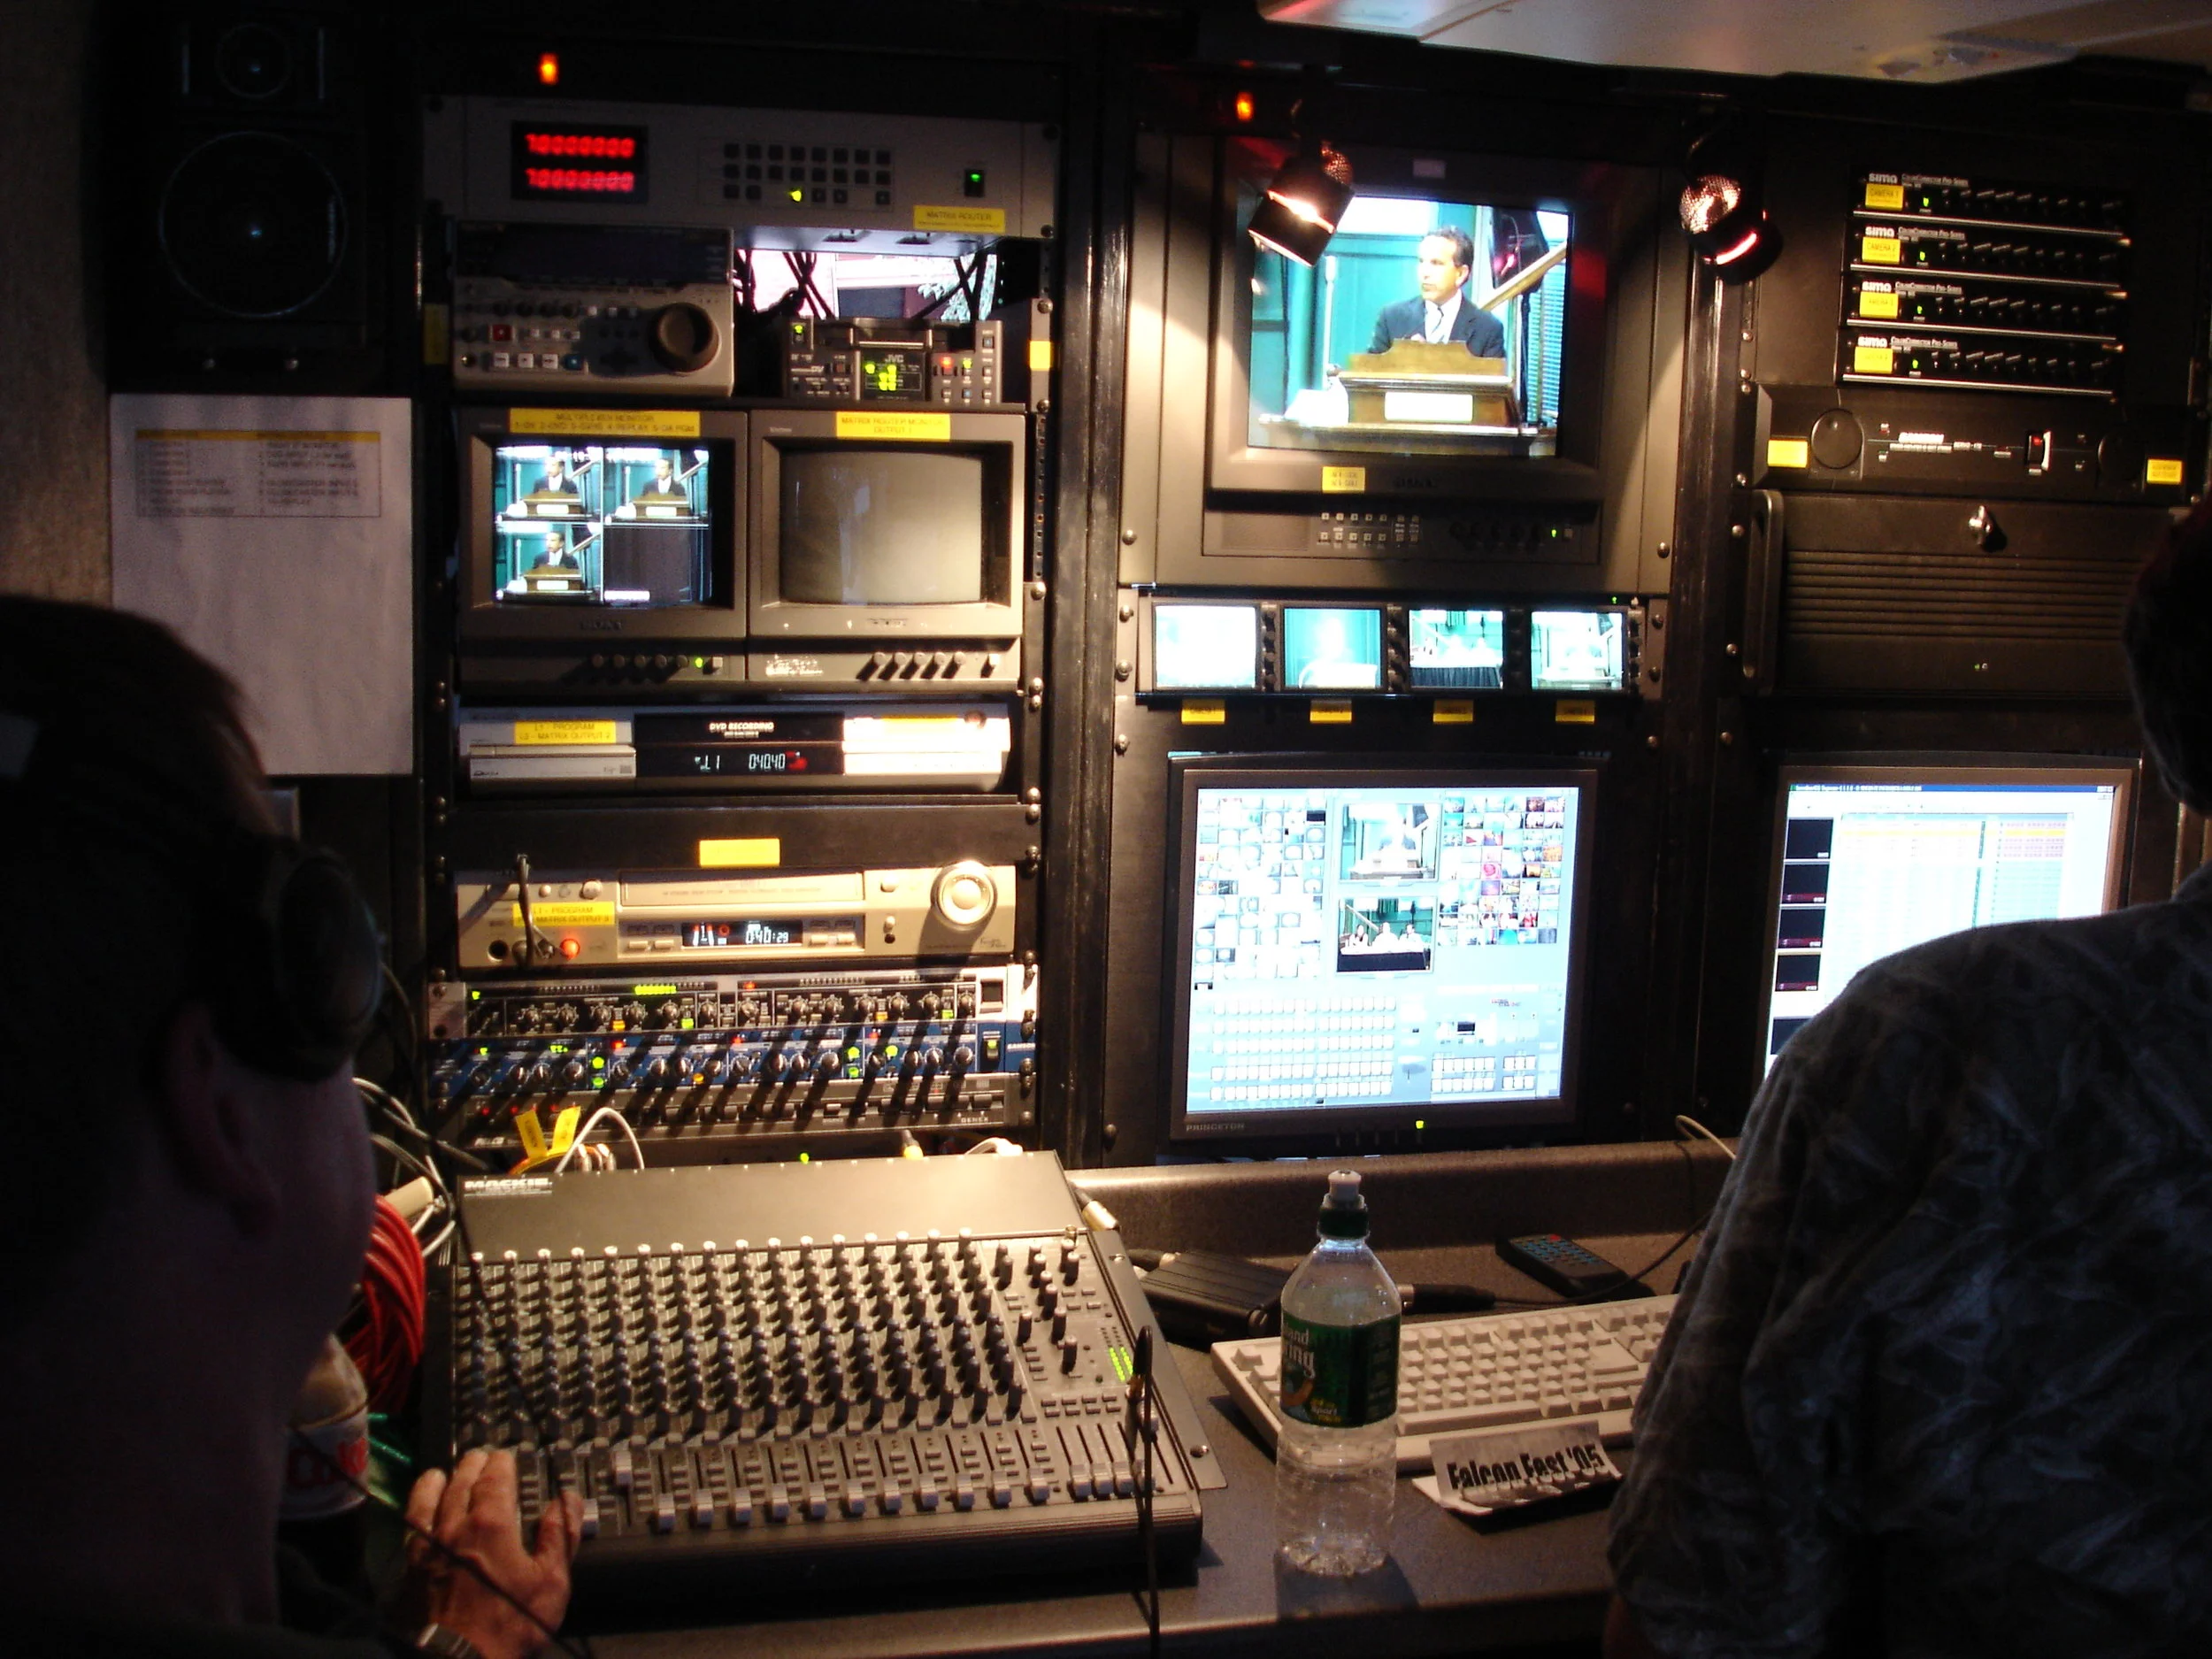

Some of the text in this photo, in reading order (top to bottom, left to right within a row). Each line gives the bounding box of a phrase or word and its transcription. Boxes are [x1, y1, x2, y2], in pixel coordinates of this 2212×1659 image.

[885, 355, 904, 364] JVC
[728, 722, 774, 732] RECORDING
[1447, 1460, 1521, 1490] Falcon
[1519, 1452, 1568, 1479] Fest
